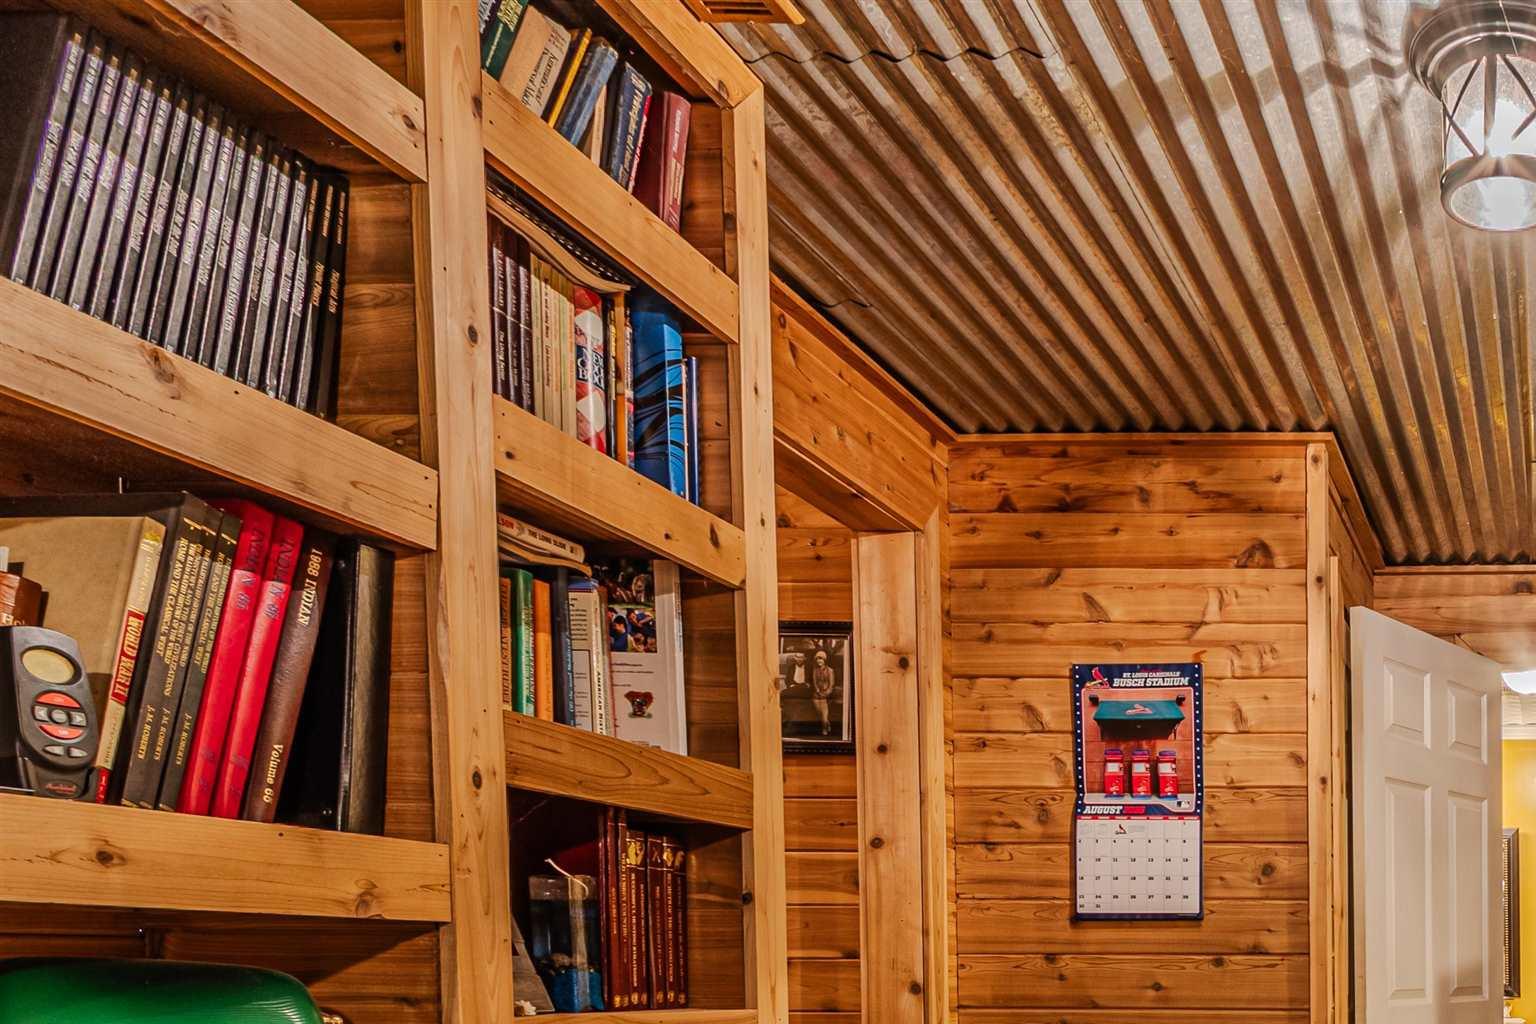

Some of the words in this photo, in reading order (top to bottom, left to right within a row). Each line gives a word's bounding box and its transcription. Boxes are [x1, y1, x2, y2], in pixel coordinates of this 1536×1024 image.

[307, 548, 323, 577] 1988
[296, 578, 318, 626] INDIAN
[120, 615, 144, 657] WORLD
[114, 655, 135, 685] WAR
[1113, 678, 1145, 687] BUSCH
[1146, 677, 1189, 686] STADIUM
[111, 682, 128, 696] II
[266, 744, 284, 785] Volume
[1082, 805, 1123, 814] AUGUST
